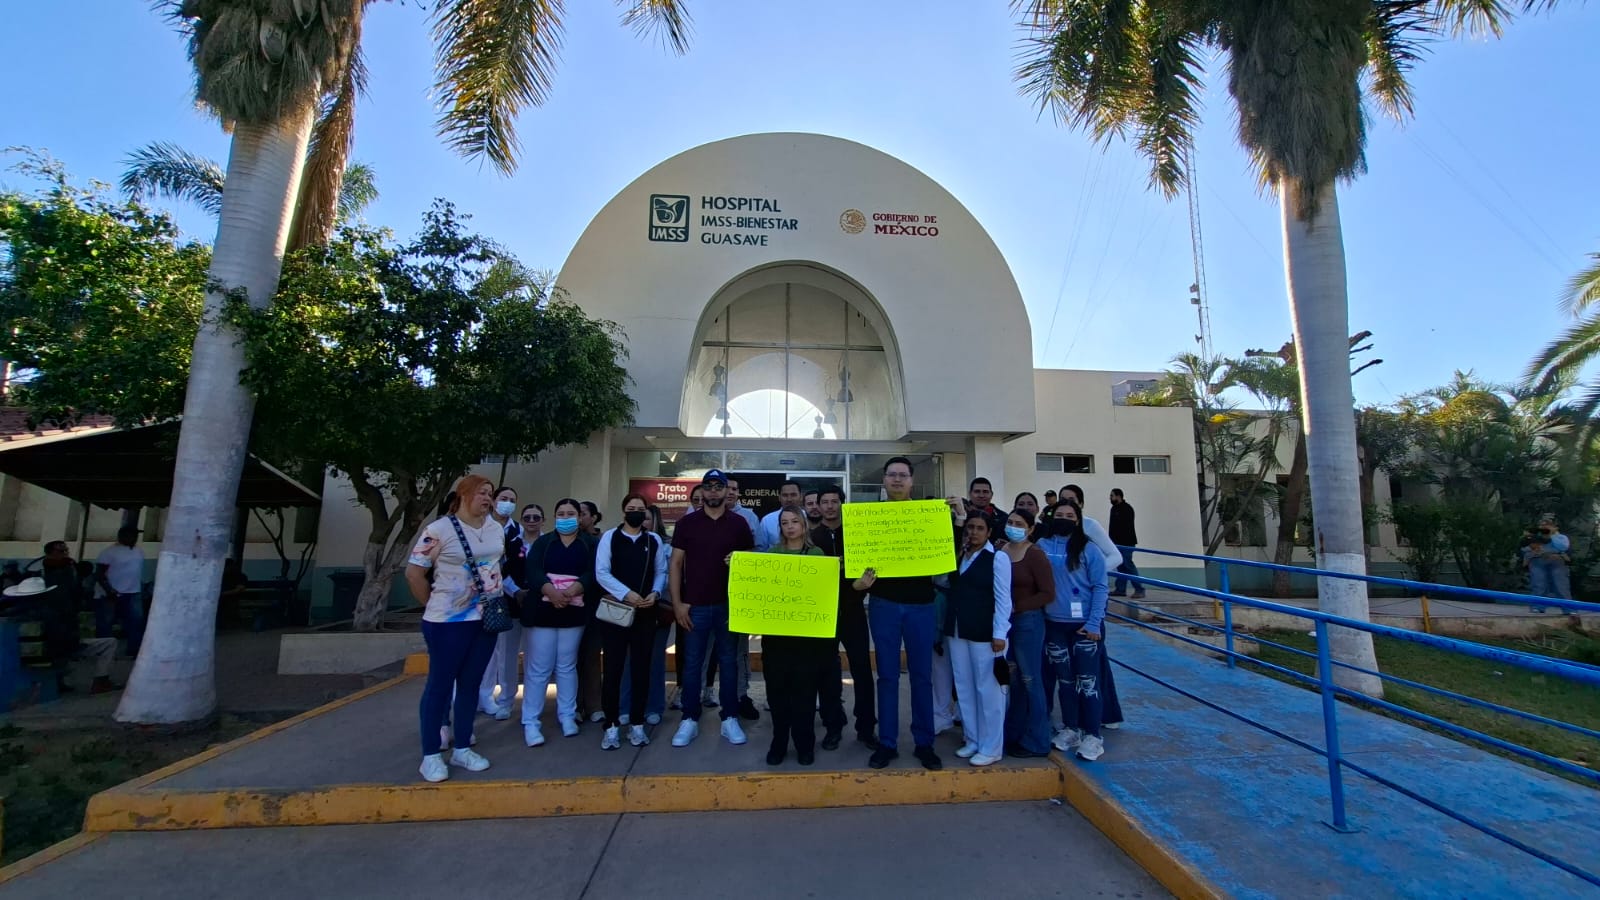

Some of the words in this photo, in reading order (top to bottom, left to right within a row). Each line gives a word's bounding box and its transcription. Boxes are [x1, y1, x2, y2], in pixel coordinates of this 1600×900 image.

[701, 196, 781, 212] HOSPITAL
[701, 215, 798, 230] IMSS-BIENESTAR
[872, 213, 919, 223] GOBIERNO
[924, 215, 937, 223] DE
[652, 227, 686, 240] IMSS
[874, 221, 939, 236] MÉXICO
[701, 232, 769, 247] GUASAVE
[657, 484, 687, 492] Trato
[745, 489, 780, 497] GENERAL
[657, 492, 687, 502] Digno
[736, 499, 761, 507] ASAVE
[901, 506, 915, 516] los
[732, 553, 780, 571] Respeto
[784, 562, 792, 572] a
[798, 558, 818, 574] los
[771, 575, 782, 586] de
[786, 576, 803, 588] los
[731, 608, 830, 623] IMSS-BIENESTAR
